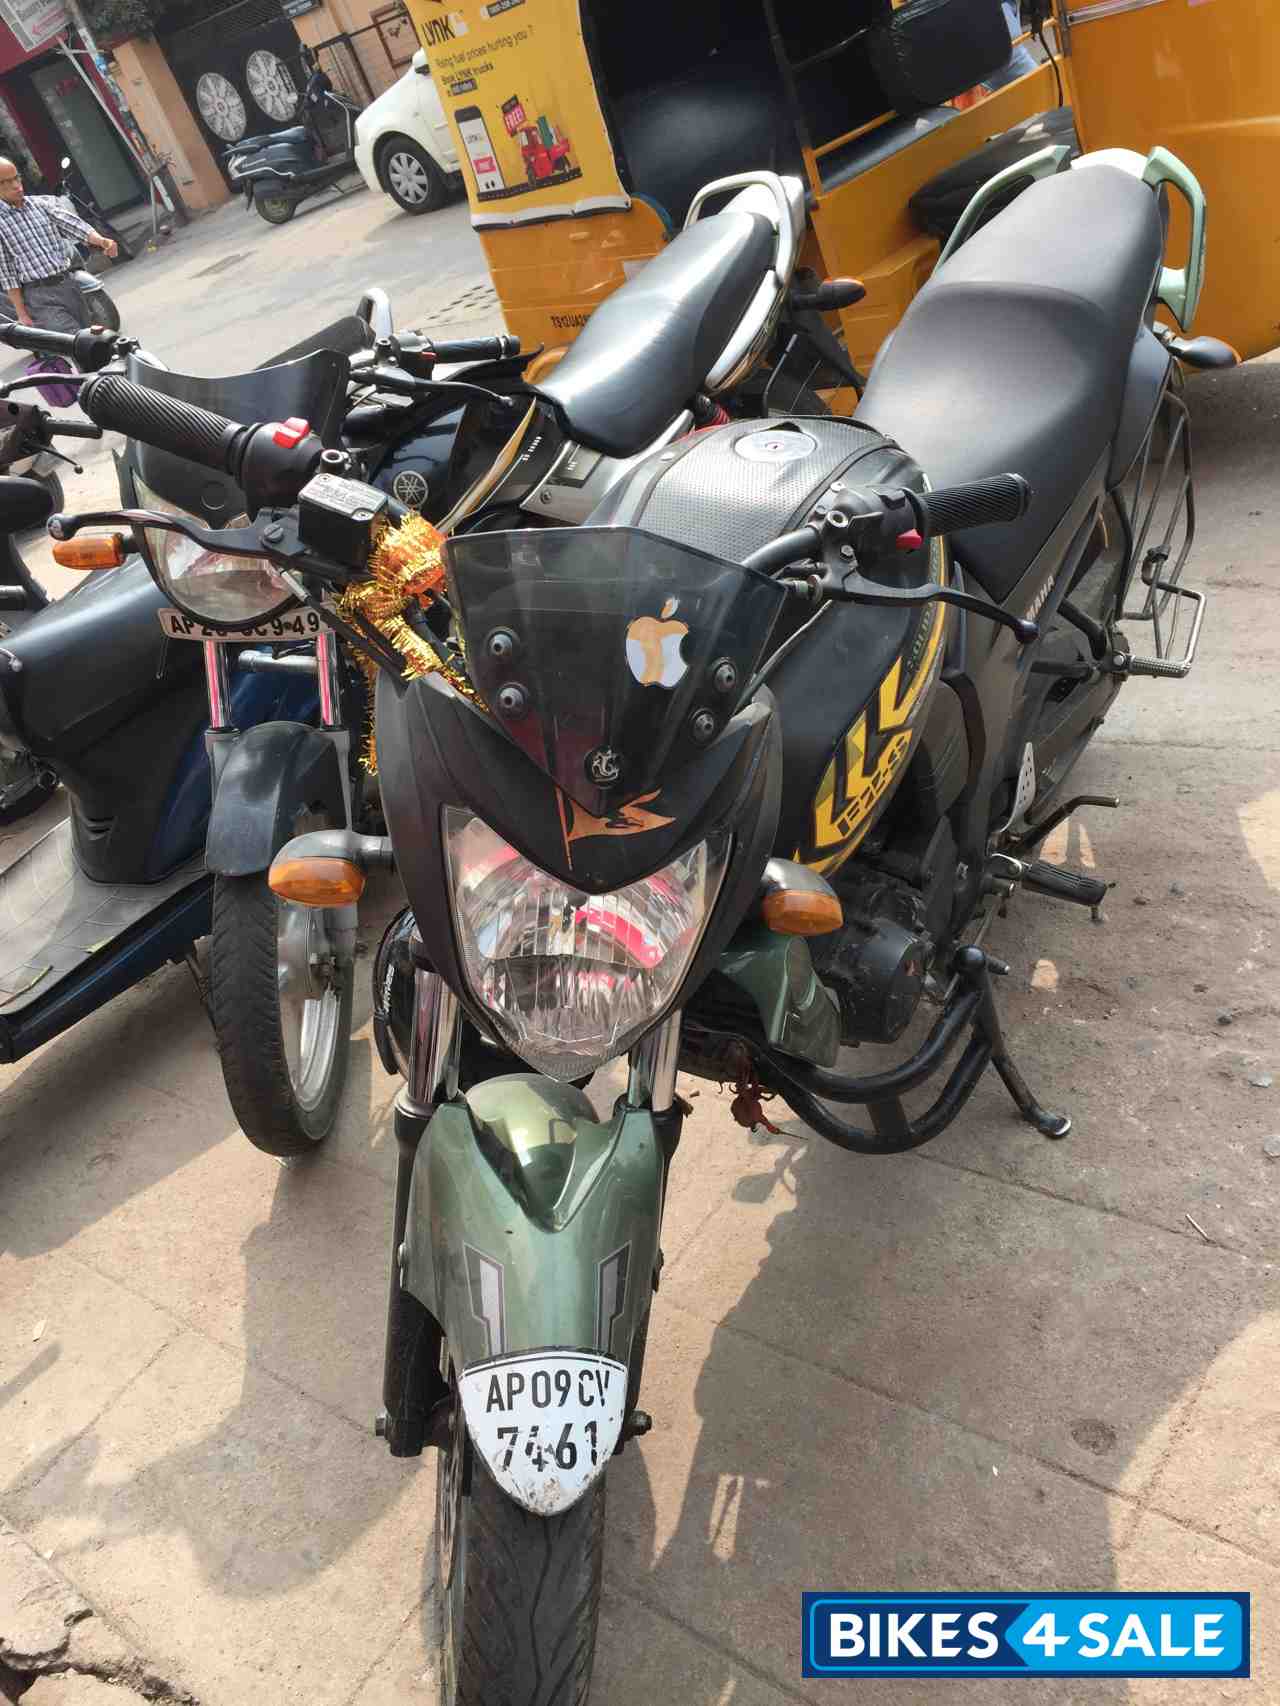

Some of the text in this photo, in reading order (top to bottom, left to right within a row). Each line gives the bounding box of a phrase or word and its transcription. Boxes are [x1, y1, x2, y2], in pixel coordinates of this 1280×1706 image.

[512, 31, 528, 46] you
[486, 1371, 526, 1413] AP
[531, 1369, 572, 1409] 09
